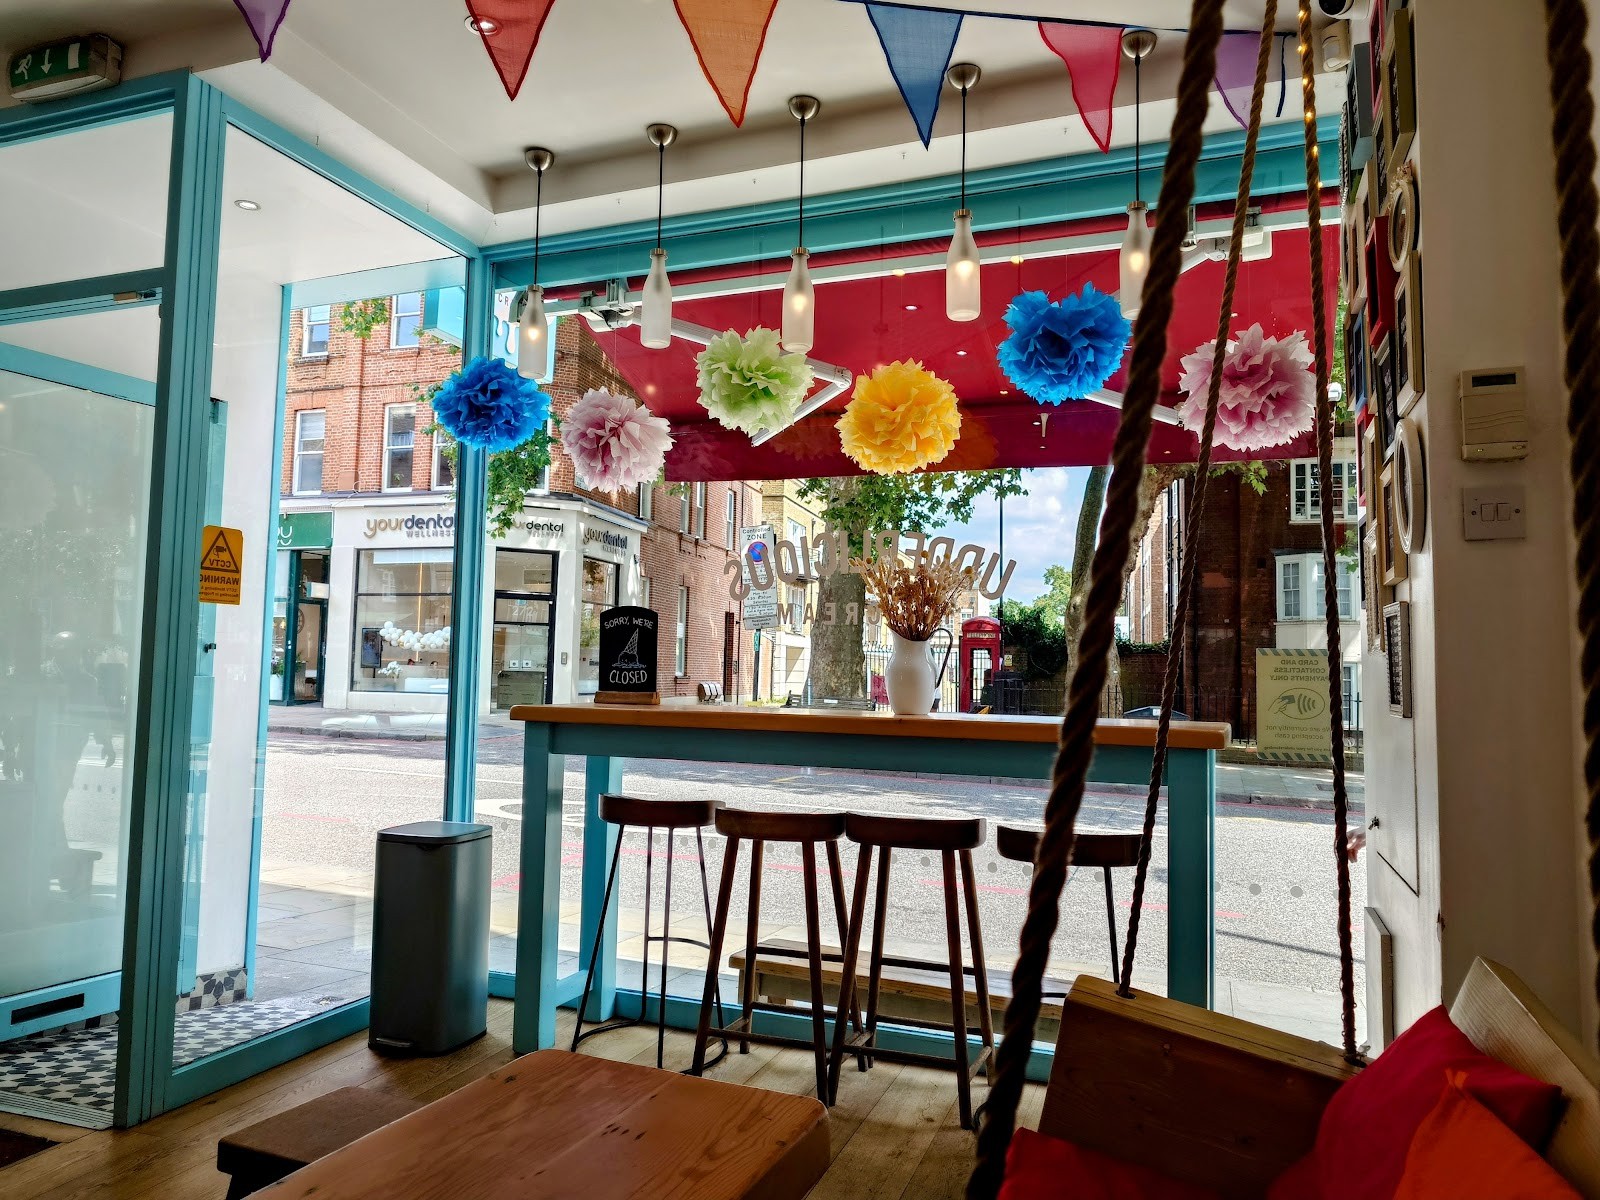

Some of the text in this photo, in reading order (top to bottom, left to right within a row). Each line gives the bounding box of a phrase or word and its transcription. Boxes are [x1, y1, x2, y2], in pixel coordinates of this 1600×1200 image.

[363, 513, 455, 539] yourdenta
[406, 530, 455, 538] WELLNES
[746, 532, 767, 541] ZONE
[604, 616, 630, 629] SORRY,
[609, 669, 648, 685] CLOSED
